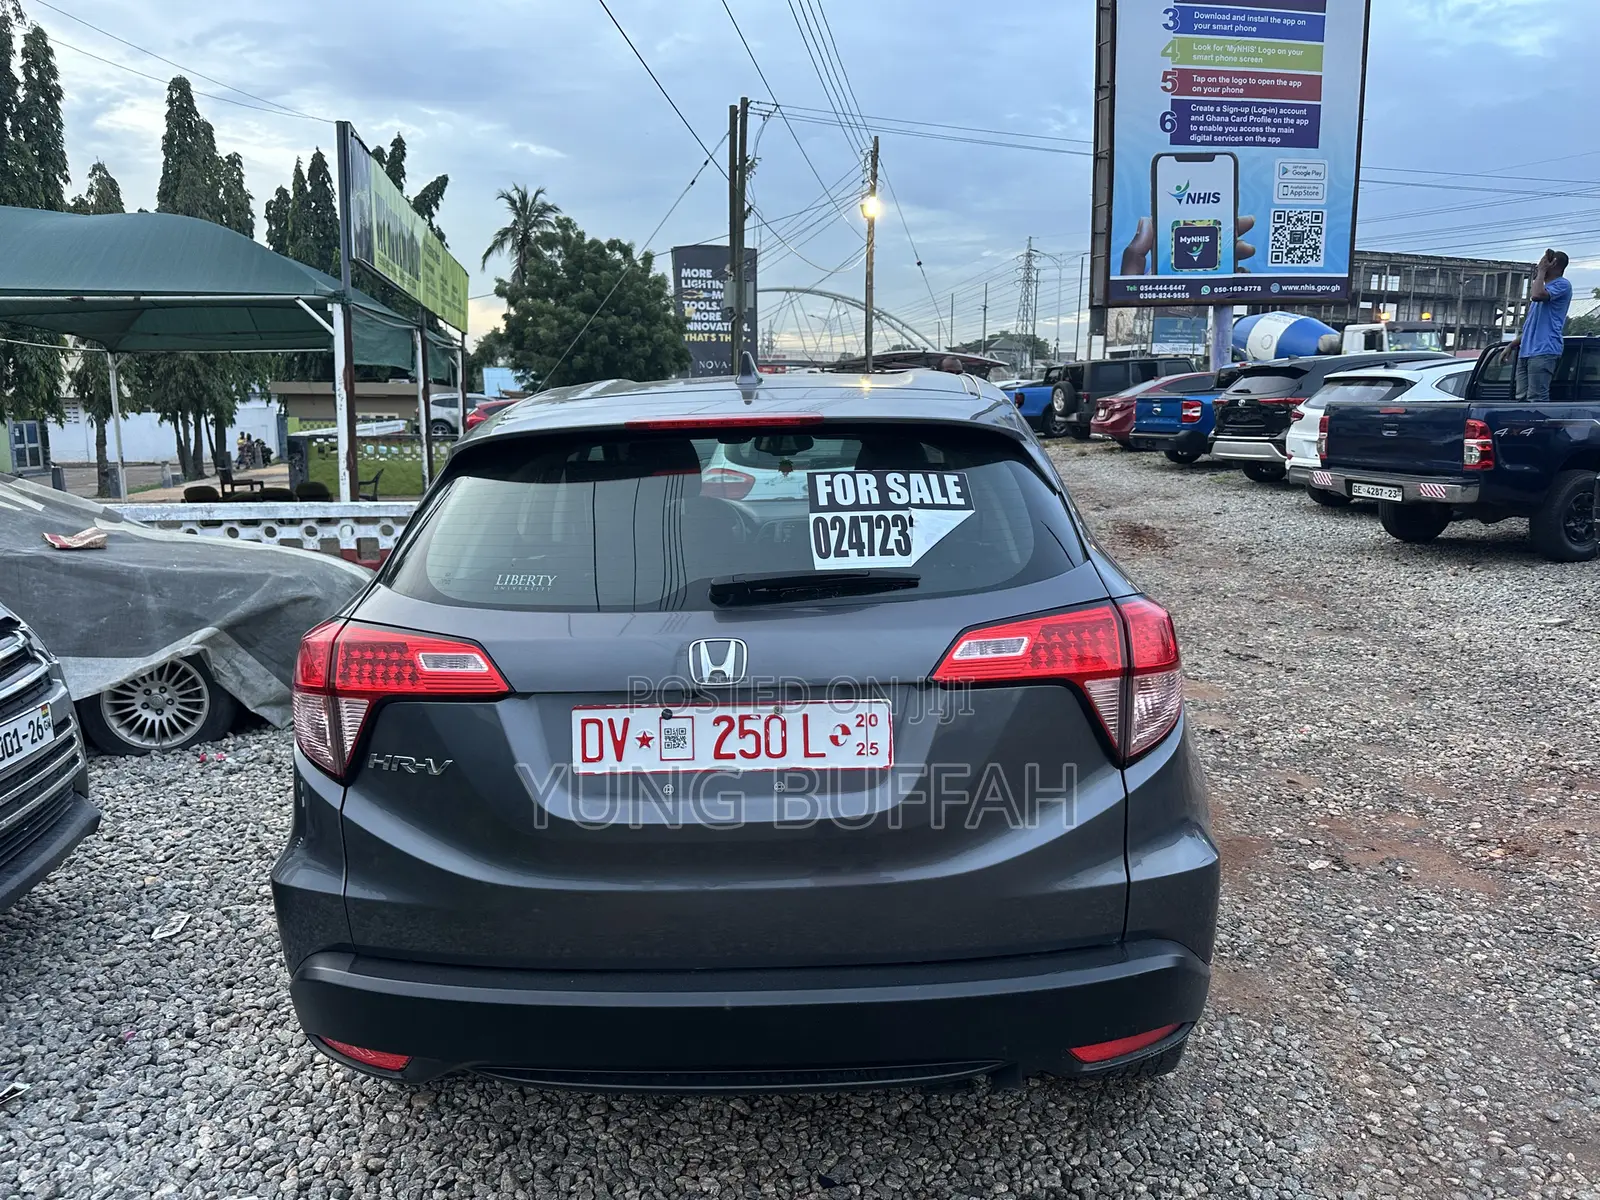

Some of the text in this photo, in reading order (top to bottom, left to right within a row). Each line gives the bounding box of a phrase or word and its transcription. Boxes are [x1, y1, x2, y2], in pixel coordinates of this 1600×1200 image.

[1162, 8, 1180, 31] 3
[1194, 11, 1230, 20] Download
[1247, 15, 1269, 23] install
[1160, 39, 1180, 62] 4
[1258, 47, 1275, 55] Logo
[1160, 70, 1179, 93] 5
[1192, 75, 1206, 83] Tap
[1232, 77, 1247, 85] logo
[1191, 104, 1214, 112] Create
[1222, 105, 1249, 114] Sign-up
[1251, 105, 1278, 115] (Log-in)
[1159, 110, 1177, 133] 6
[1190, 134, 1212, 142] digital
[1186, 192, 1221, 204] NHIS
[1180, 236, 1210, 244] MyNHIS
[681, 268, 712, 278] MORE
[682, 280, 724, 289] LIGHTIN
[1282, 284, 1340, 292] www.nhis.gov.gh
[682, 301, 720, 310] TOOLS.
[692, 312, 722, 321] MORE
[683, 333, 716, 342] THAT'S
[699, 360, 728, 369] NOVA
[816, 473, 965, 506] FOR SALE
[1354, 485, 1362, 494] GE
[495, 574, 557, 586] LIBERTY
[581, 714, 826, 763] DV 250 L
[368, 753, 453, 775] HR-V
